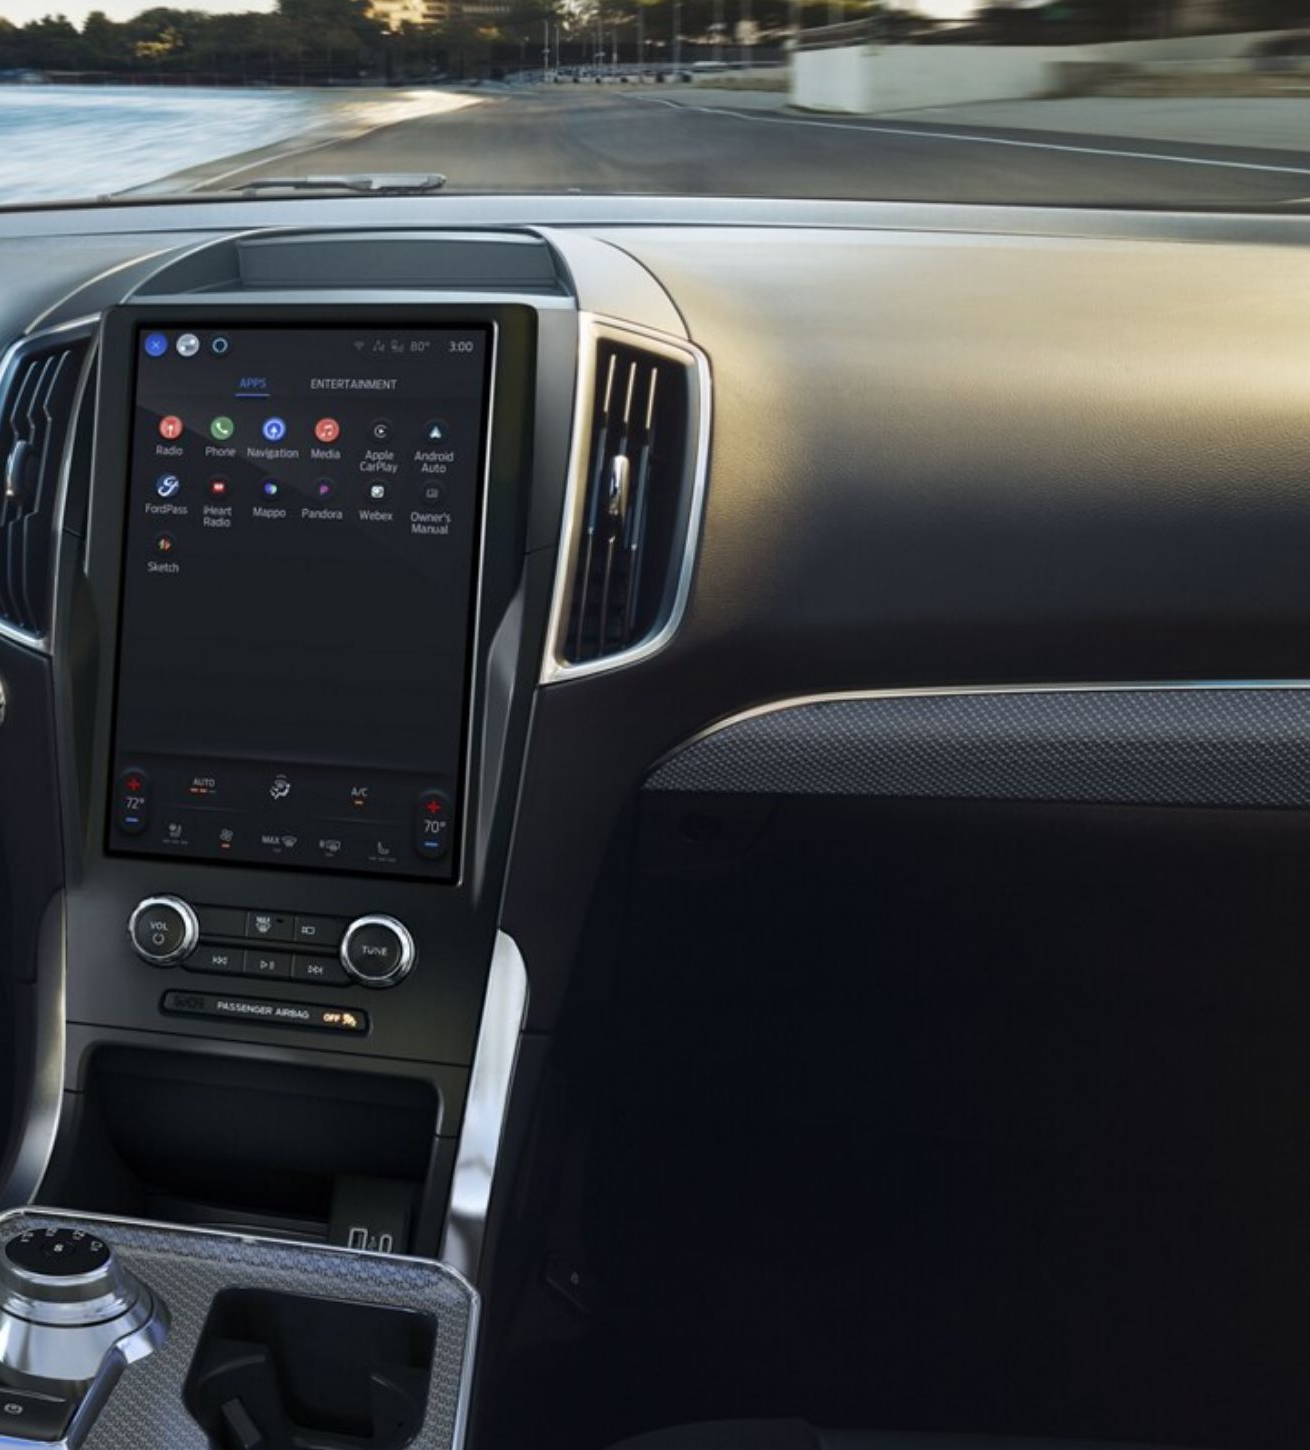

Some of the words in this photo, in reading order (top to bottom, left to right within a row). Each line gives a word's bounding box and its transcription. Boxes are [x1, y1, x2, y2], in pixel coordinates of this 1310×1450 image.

[449, 340, 474, 352] 3:00
[239, 377, 267, 389] APPS
[310, 378, 398, 390] ENTERTAINMENT
[155, 444, 183, 456] Radio
[205, 446, 236, 457] Phone
[247, 448, 299, 460] Navigation
[311, 448, 341, 459] Media
[364, 450, 395, 461] Apple
[414, 451, 454, 462] Android
[359, 461, 399, 473] CarPlay
[421, 463, 447, 473] Auto
[145, 503, 188, 515] FordPass
[203, 505, 232, 516] iHeart
[253, 507, 287, 519] Mappo
[302, 508, 343, 520] Pandora
[203, 516, 231, 527] Radio
[359, 510, 393, 521] Webex
[410, 511, 452, 523] Owner's
[411, 523, 449, 534] Manual
[147, 560, 180, 572] Sketch
[192, 777, 216, 788] AUTO
[351, 787, 368, 797] A/C
[126, 796, 145, 809] 72°
[424, 819, 447, 833] 70°
[150, 921, 169, 931] VOL
[362, 944, 388, 957] TUNE
[216, 1001, 273, 1016] PASSENGER
[274, 1008, 311, 1020] AIRBAG
[322, 1012, 341, 1023] OFF
